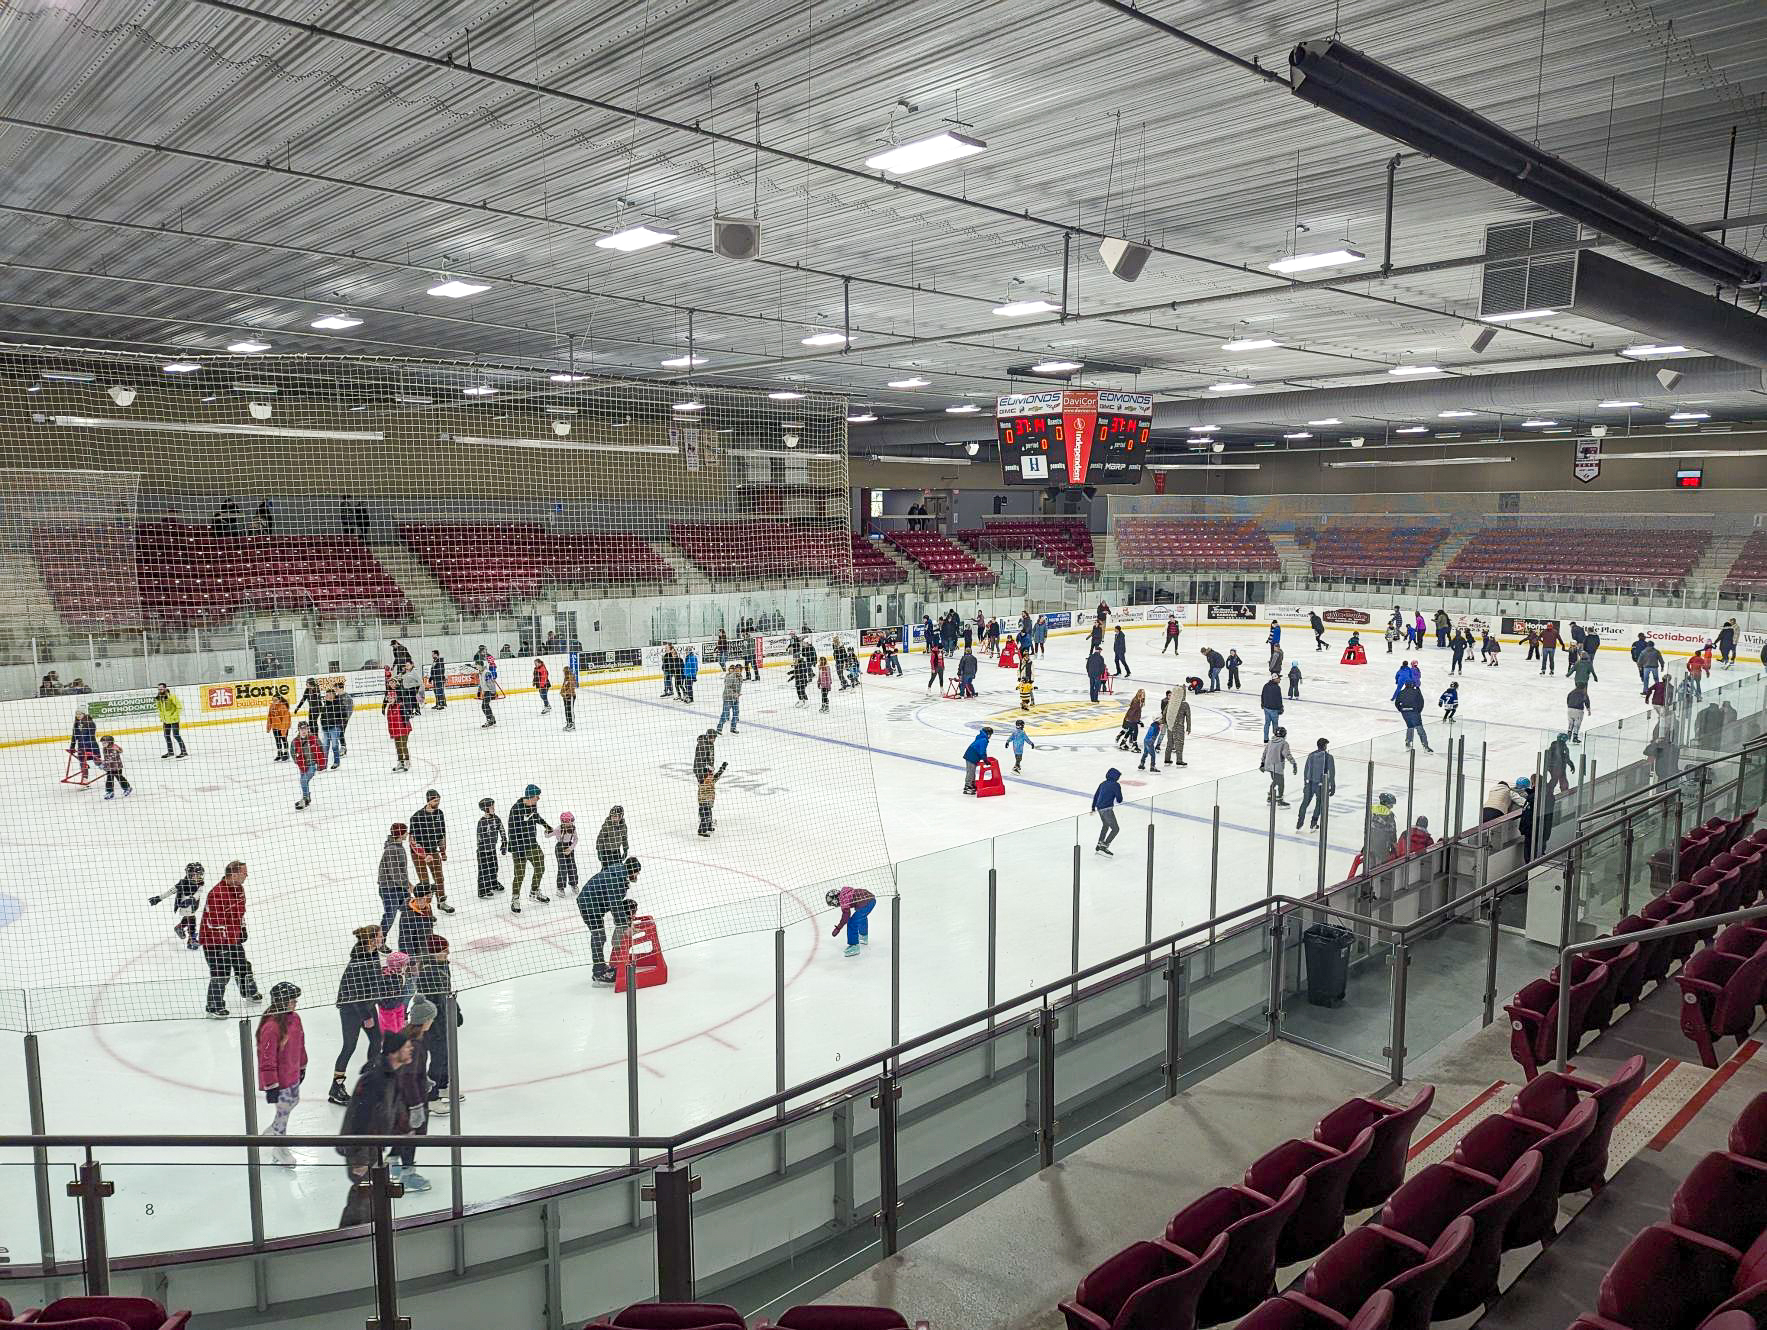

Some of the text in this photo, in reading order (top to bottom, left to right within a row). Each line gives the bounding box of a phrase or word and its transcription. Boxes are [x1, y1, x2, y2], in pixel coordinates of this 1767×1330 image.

[999, 393, 1061, 406] EDMONDS
[1063, 397, 1097, 406] DaviCor
[1100, 392, 1151, 404] EDMONDS
[1073, 430, 1084, 482] Independent
[1601, 626, 1625, 635] Place
[1645, 630, 1705, 644] Scotiabank
[235, 684, 290, 700] Home
[108, 696, 154, 707] ALGONQUIN
[101, 703, 157, 713] ORTHODONTIC
[145, 1203, 155, 1216] 8
